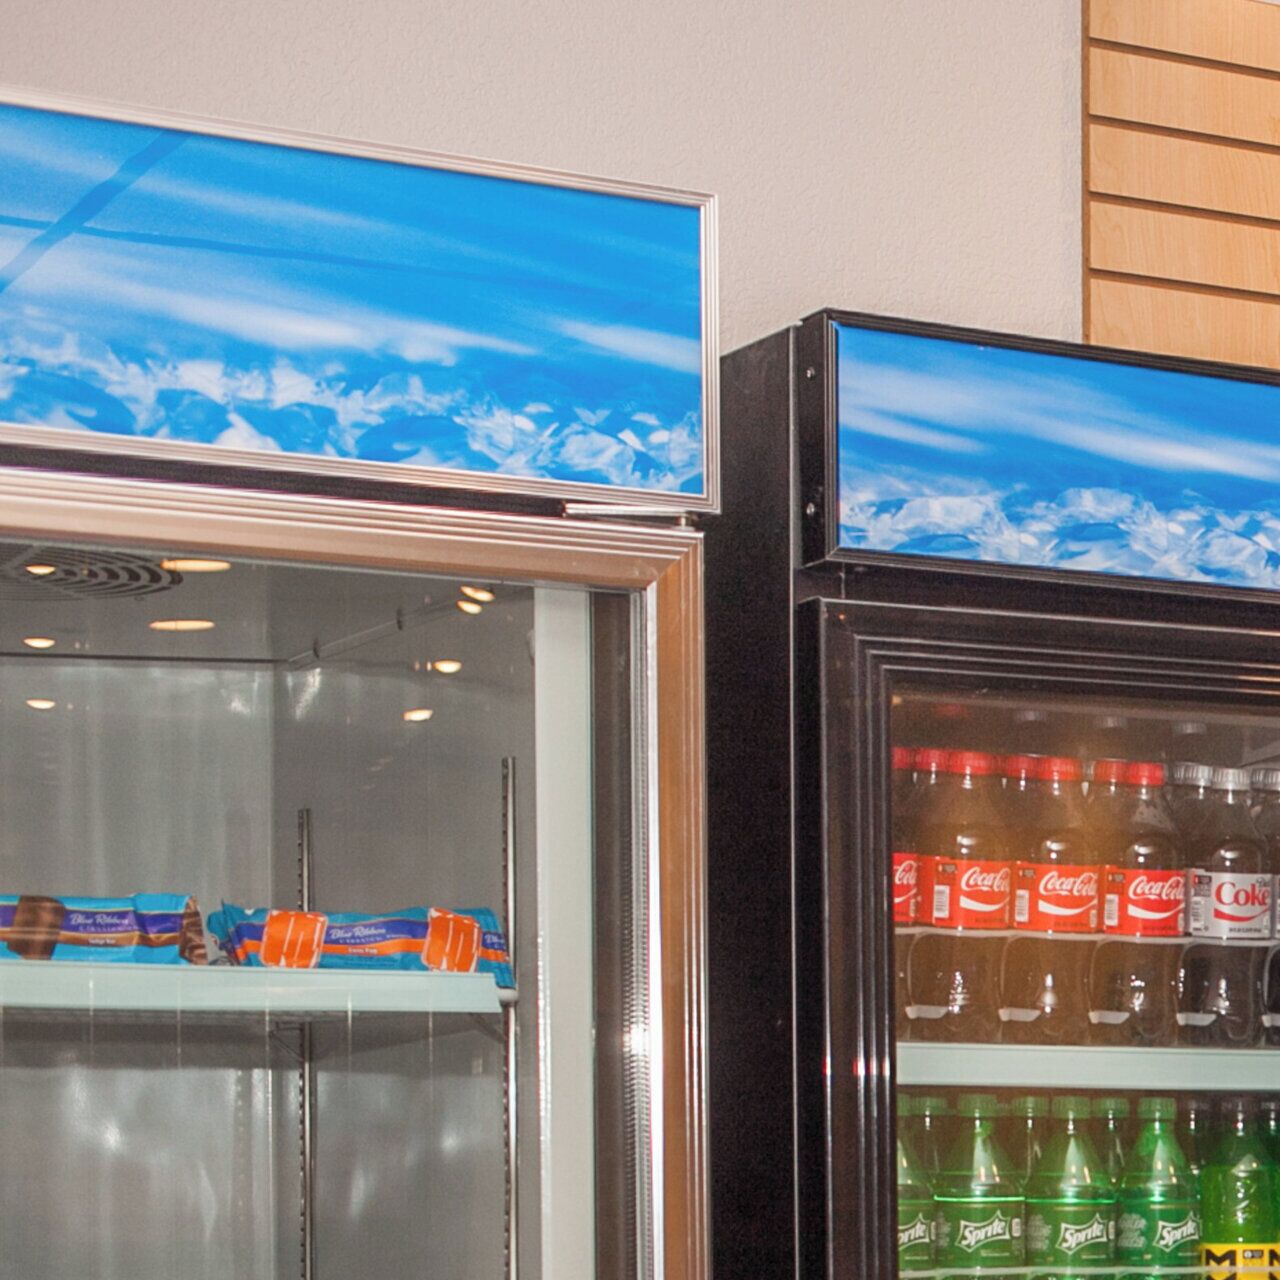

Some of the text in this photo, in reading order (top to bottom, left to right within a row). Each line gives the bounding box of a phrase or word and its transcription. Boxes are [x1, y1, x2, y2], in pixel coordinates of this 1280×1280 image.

[1214, 881, 1270, 908] Coke
[69, 912, 93, 926] Blue
[330, 926, 387, 939] Blue Ribbon
[960, 1219, 1006, 1247] Sprite
[1063, 1221, 1104, 1248] Sprite
